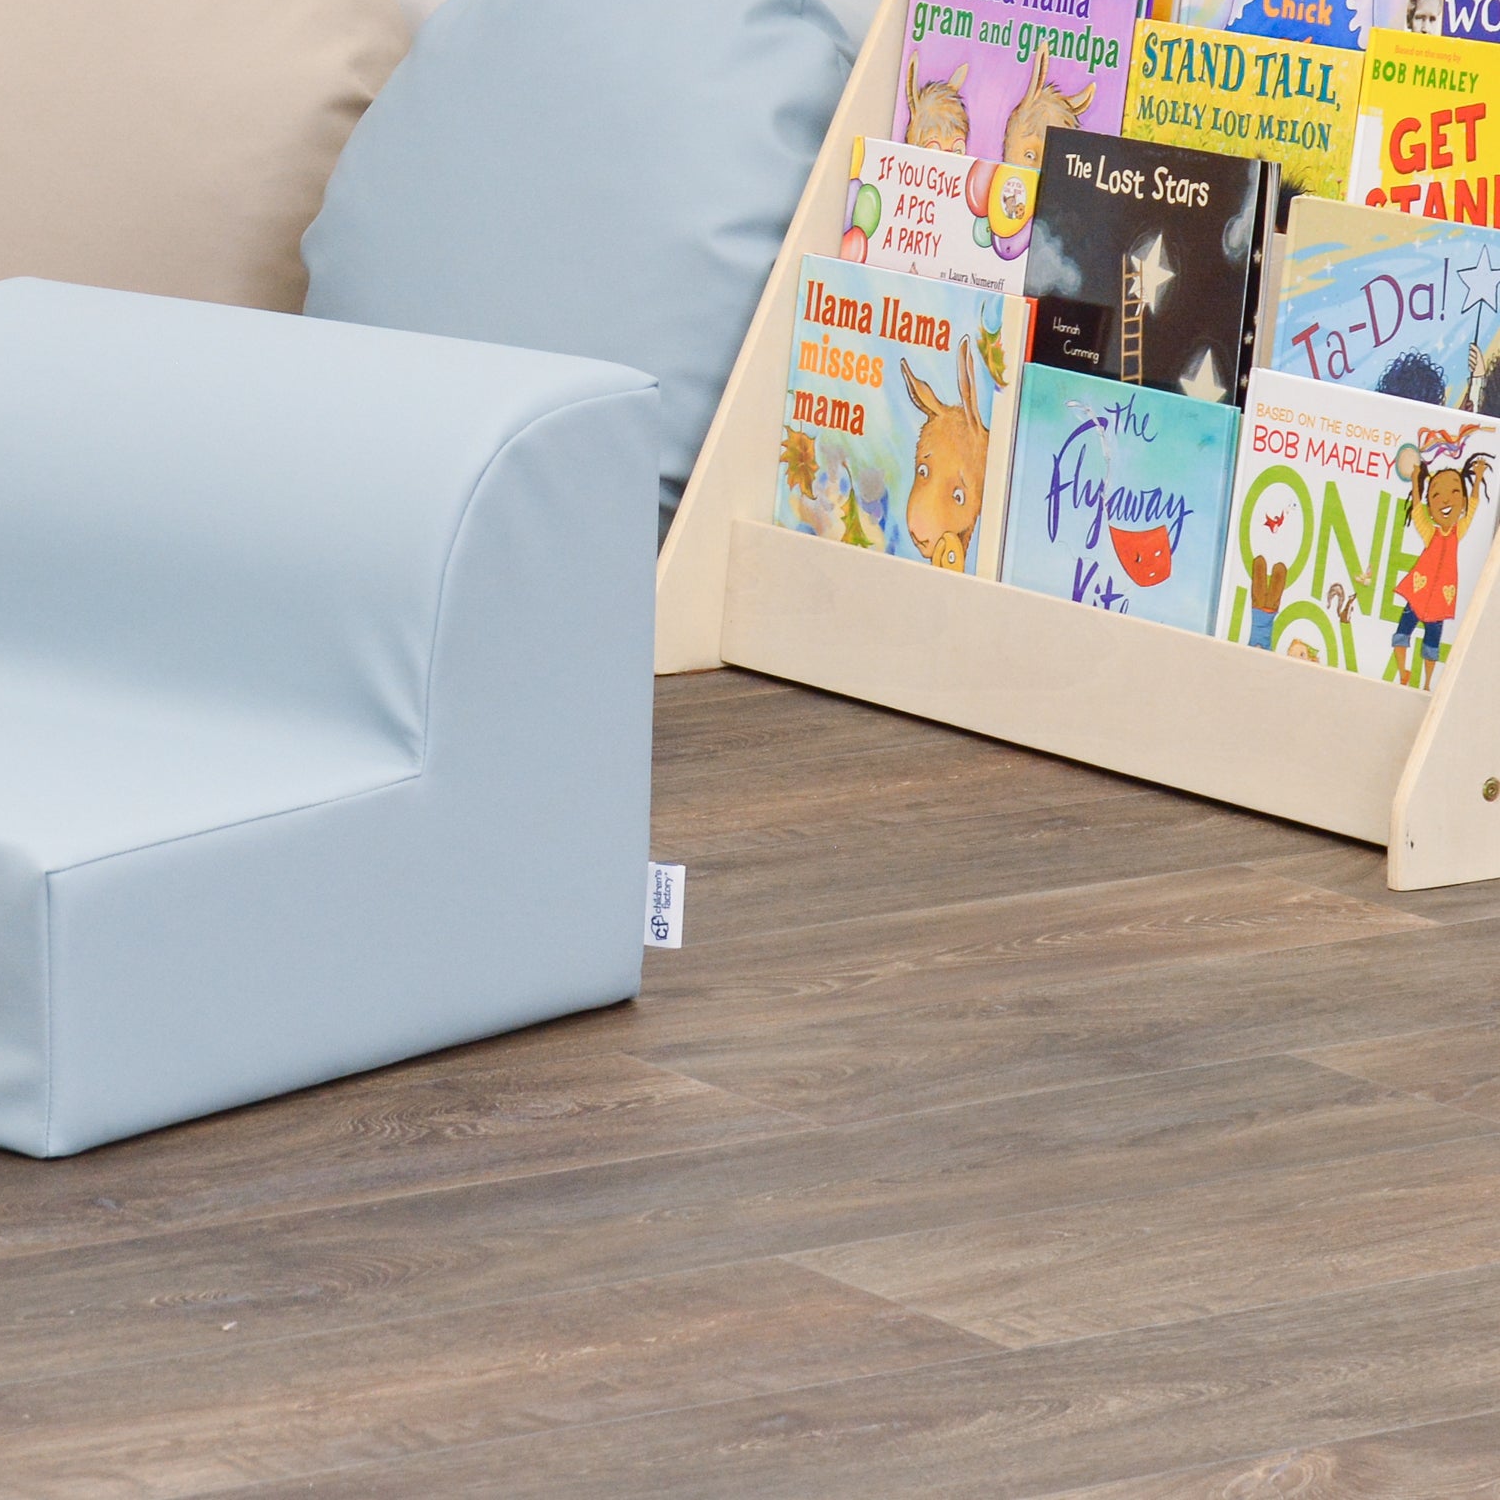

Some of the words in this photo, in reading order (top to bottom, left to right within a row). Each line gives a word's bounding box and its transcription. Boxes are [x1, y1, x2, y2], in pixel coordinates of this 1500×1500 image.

[912, 1, 974, 42] gram
[979, 19, 1013, 46] and
[1016, 22, 1119, 73] grandpa
[1142, 31, 1245, 92] STAND
[1255, 52, 1341, 112] TALL,
[1372, 59, 1407, 84] BOB
[1412, 64, 1479, 93] MARLEY
[1137, 95, 1207, 130] MOLLY
[1211, 107, 1251, 139] LOU
[1255, 114, 1332, 152] MELON
[1389, 102, 1486, 175] GET
[878, 156, 895, 181] IF
[898, 161, 925, 187] YOU
[927, 166, 962, 199] GIVE
[1066, 154, 1092, 179] The
[1095, 155, 1145, 199] Lost
[1152, 166, 1210, 207] Stars
[894, 194, 904, 217] A
[908, 195, 936, 225] PIG
[882, 226, 893, 250] A
[897, 227, 942, 258] PARTY
[949, 268, 968, 283] Laura
[970, 273, 1006, 291] Numeroff
[804, 280, 873, 334] llama
[879, 297, 952, 352] llama
[1053, 317, 1080, 335] Hannah
[1291, 257, 1449, 380] Ta-Da!
[798, 334, 884, 388] misses
[1063, 340, 1099, 364] Cumming
[792, 390, 864, 436] mama
[1104, 392, 1157, 442] the
[1256, 403, 1294, 424] BASED
[1298, 412, 1316, 428] ON
[1320, 416, 1342, 435] THE
[1345, 423, 1380, 442] SONG
[1384, 430, 1402, 447] BY
[1253, 425, 1300, 459] BOB
[1305, 437, 1397, 480] MARLEY
[1045, 416, 1194, 556] Flyaway
